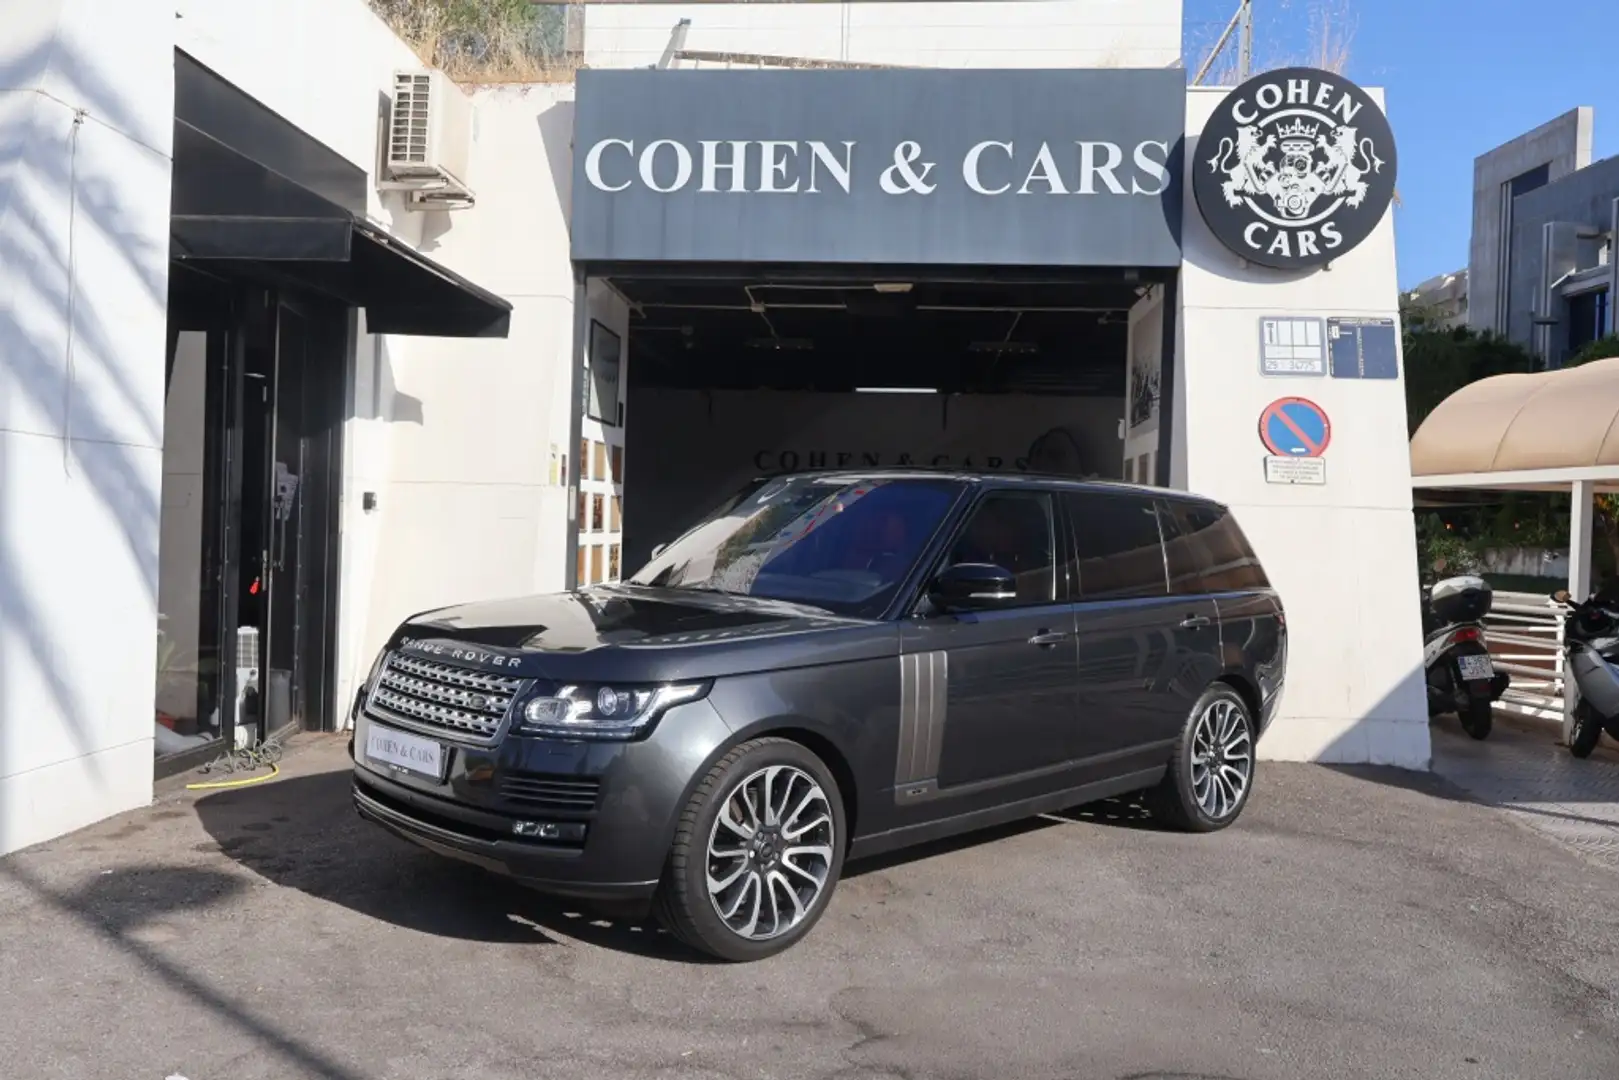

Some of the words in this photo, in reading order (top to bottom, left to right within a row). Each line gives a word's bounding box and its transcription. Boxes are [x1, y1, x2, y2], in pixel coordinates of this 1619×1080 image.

[1231, 79, 1363, 125] COHEN
[584, 138, 857, 195] COHEN
[878, 140, 937, 195] &
[962, 140, 1171, 196] CARS
[1243, 221, 1343, 257] CARS
[400, 636, 442, 655] RANGE
[452, 650, 522, 669] ROVER
